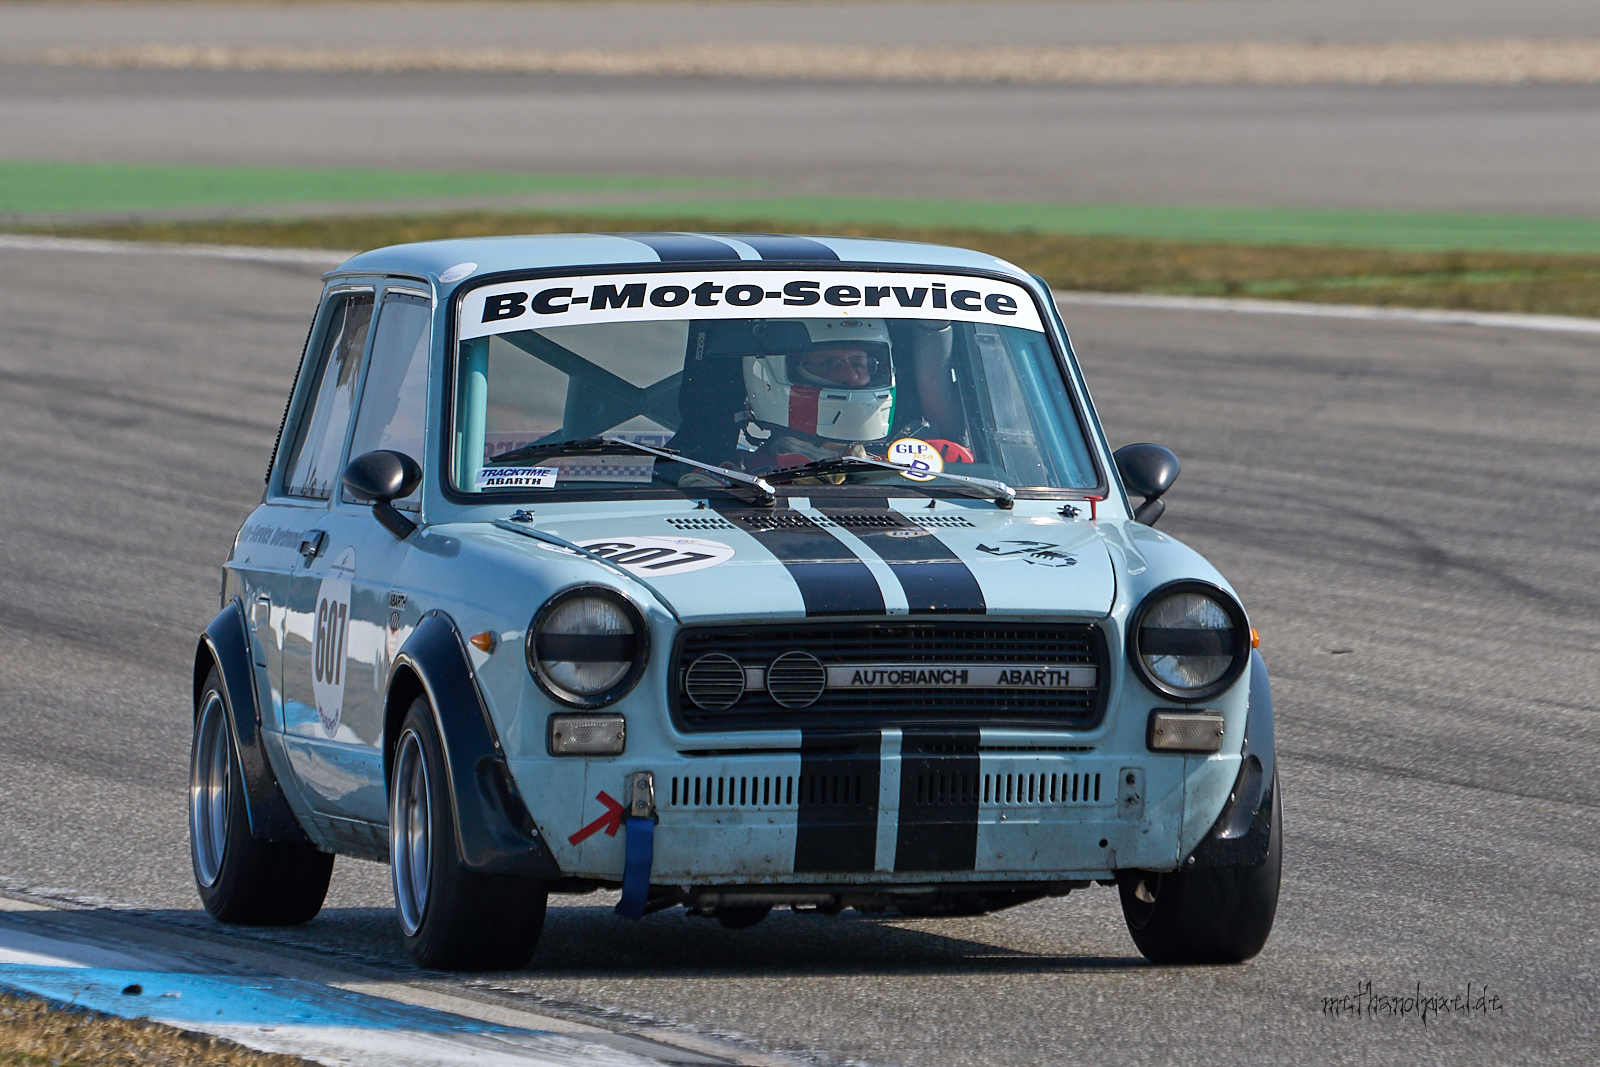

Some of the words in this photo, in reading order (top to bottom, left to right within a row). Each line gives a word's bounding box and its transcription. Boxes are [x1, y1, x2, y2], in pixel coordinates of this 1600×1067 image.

[481, 280, 1018, 323] BC-Moto-Service
[896, 444, 928, 454] GLP
[482, 469, 551, 477] TRACKTIME
[907, 460, 930, 478] B
[486, 478, 541, 486] ABARTH
[575, 542, 717, 569] 607
[316, 598, 347, 685] 607
[852, 668, 969, 686] AUTOBIANCHI
[997, 668, 1070, 687] ABARTH
